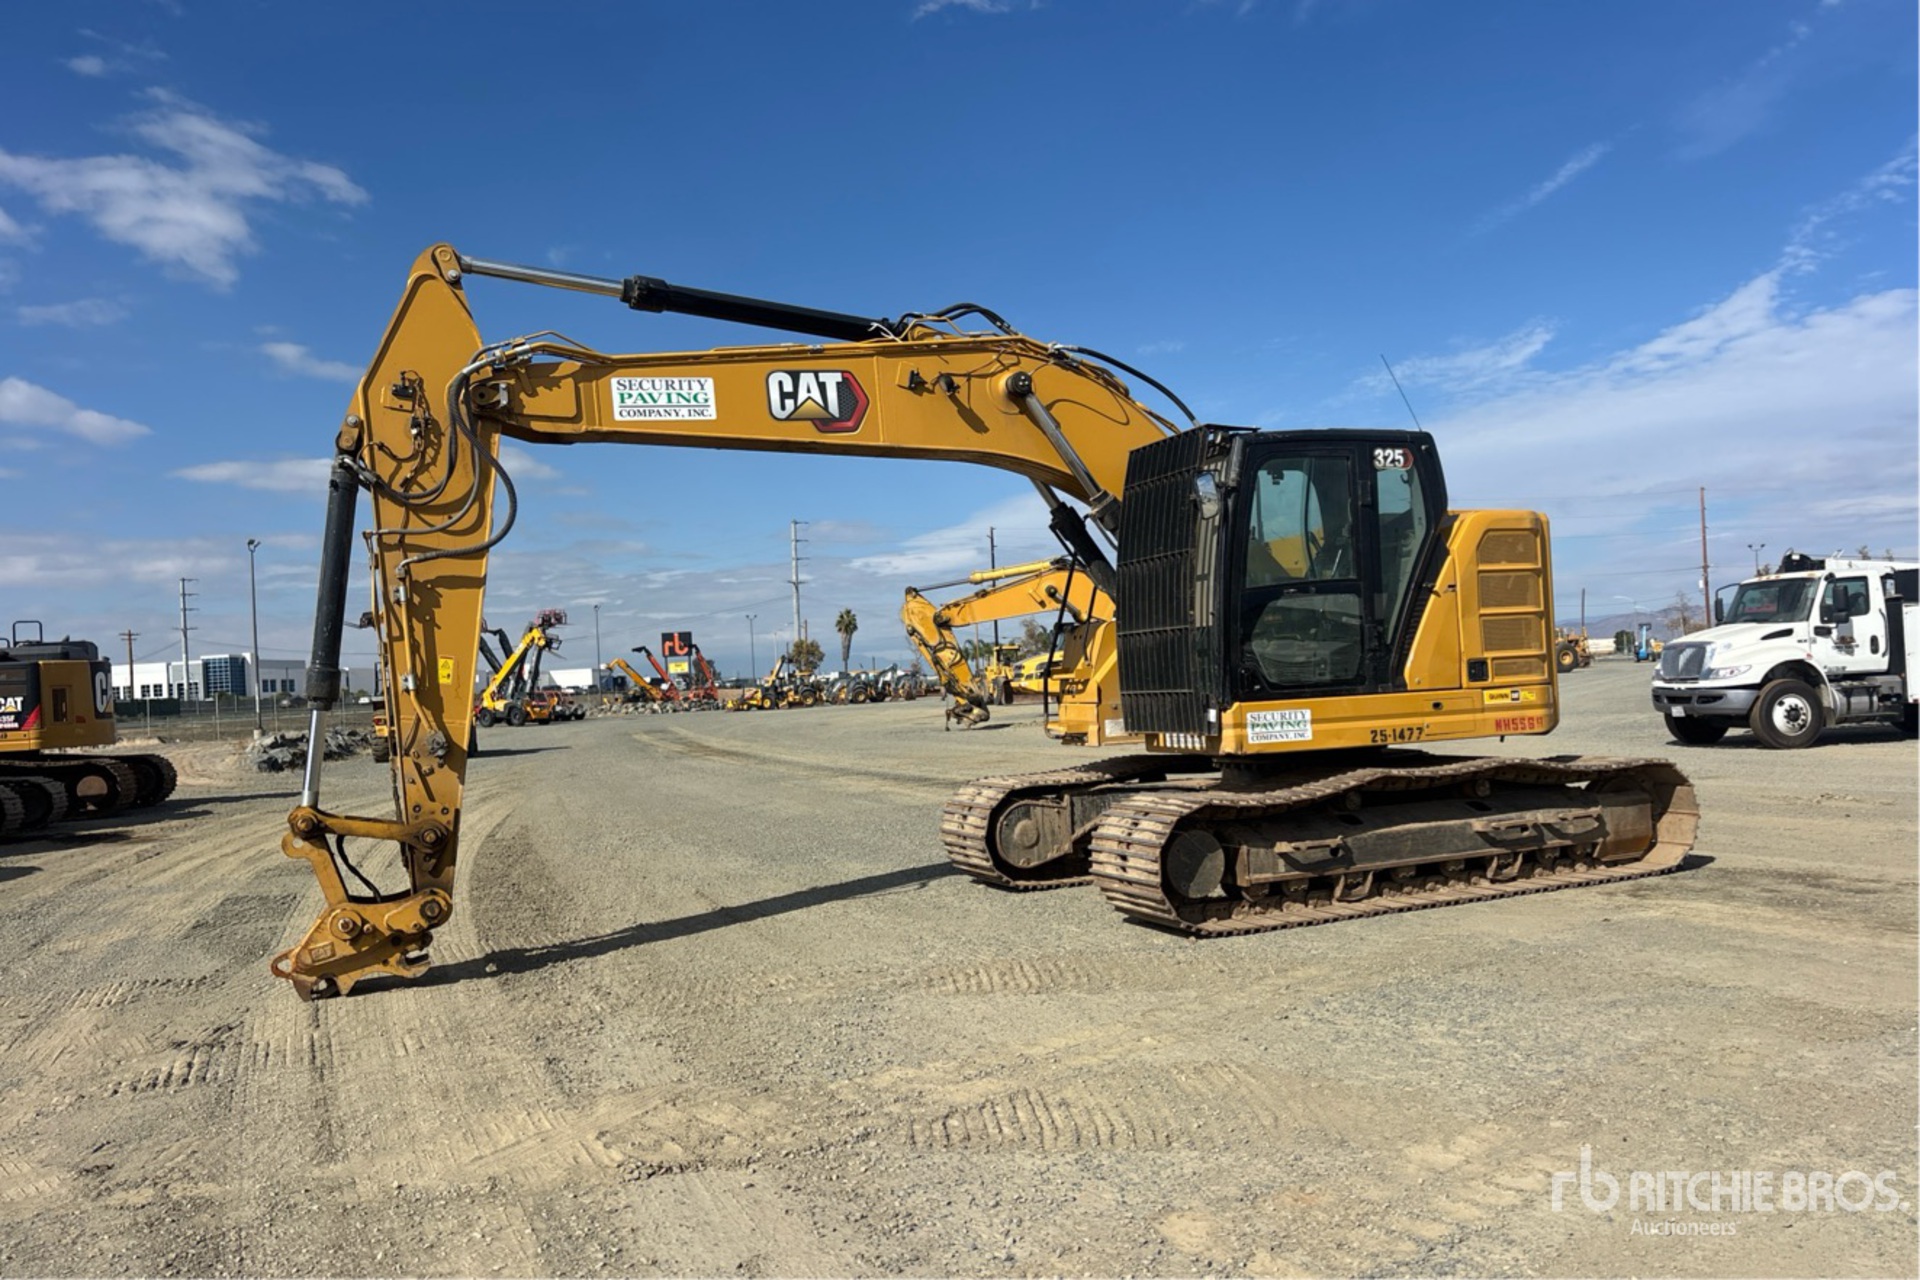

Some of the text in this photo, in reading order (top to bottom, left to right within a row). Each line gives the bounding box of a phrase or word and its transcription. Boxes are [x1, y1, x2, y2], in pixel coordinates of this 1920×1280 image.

[616, 378, 708, 392] SECURITY
[618, 391, 710, 405] PAVING
[768, 371, 843, 420] CAT
[619, 408, 712, 419] COMPANY, INC.
[1373, 447, 1404, 468] 325
[1250, 710, 1307, 722] SECURITY
[1250, 719, 1307, 732] PAVING
